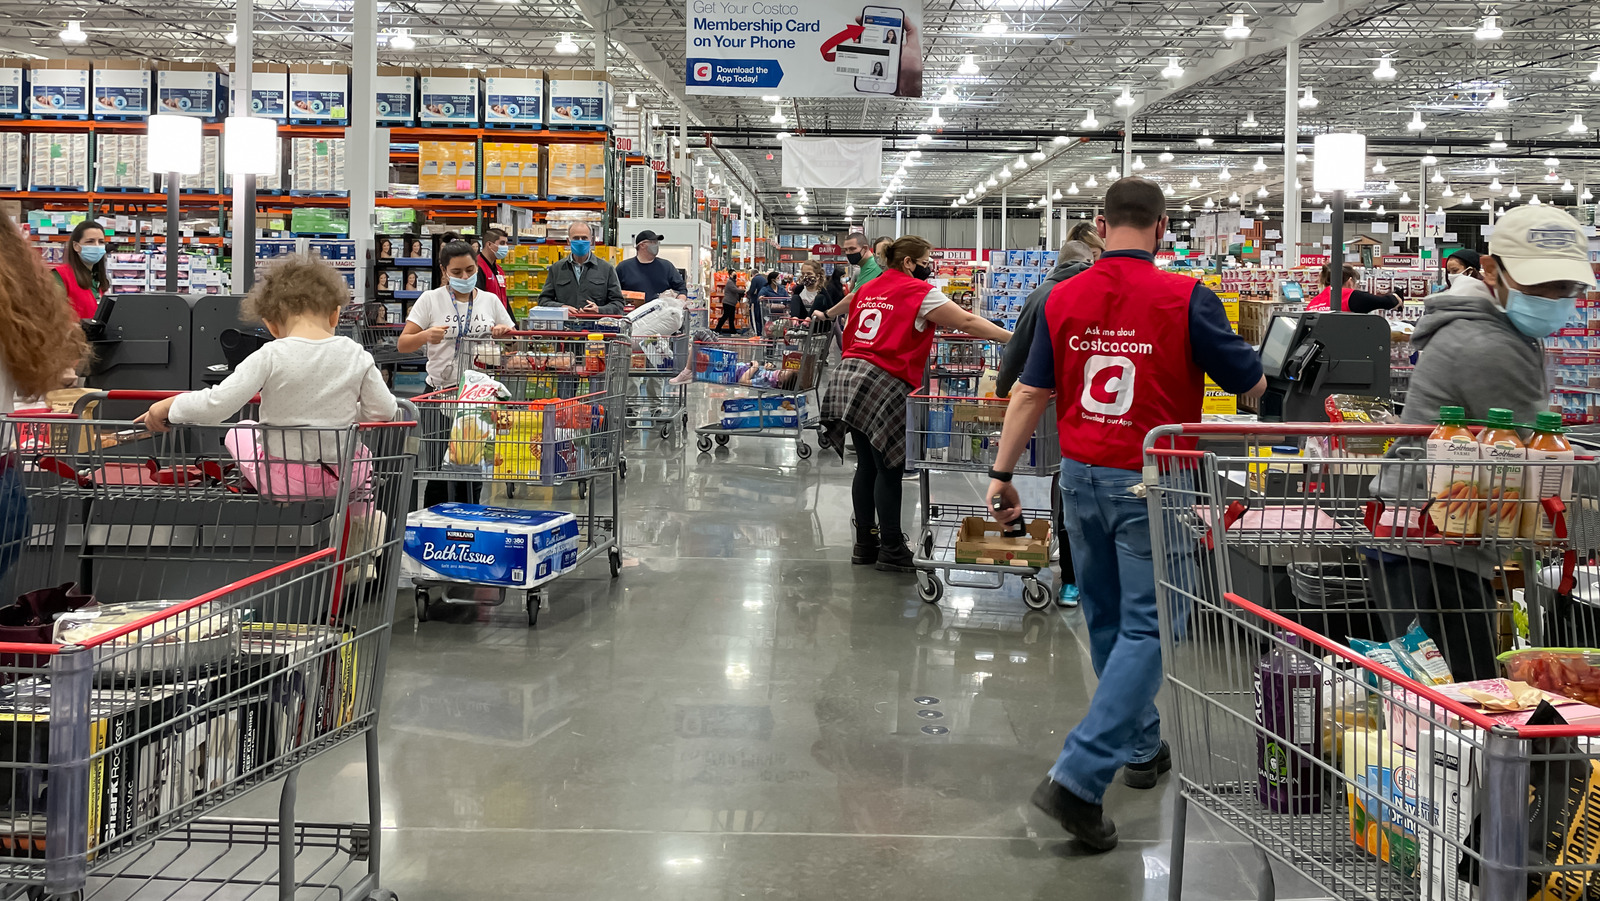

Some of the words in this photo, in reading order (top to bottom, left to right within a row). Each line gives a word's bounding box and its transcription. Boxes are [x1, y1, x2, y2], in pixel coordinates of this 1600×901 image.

[692, 0, 716, 14] Get
[720, 2, 748, 15] Your
[752, 2, 799, 15] Costco
[693, 17, 783, 34] Membership
[785, 19, 820, 32] Card
[693, 36, 711, 47] on
[714, 34, 747, 48] Your
[750, 35, 796, 49] Phone
[716, 66, 755, 75] Download
[755, 66, 769, 75] the
[716, 74, 732, 84] App
[733, 75, 758, 84] Today!
[55, 97, 61, 105] 3
[616, 137, 632, 151] 300
[651, 160, 666, 171] 302
[948, 251, 967, 259] DELI
[445, 314, 485, 323] SOCAL
[1085, 326, 1100, 335] Ask
[1069, 335, 1153, 354] Costco.com
[1081, 412, 1105, 423] Download
[1118, 418, 1133, 427] App
[1443, 442, 1477, 453] Bolthouse
[1486, 447, 1522, 459] Bolthouse
[447, 531, 474, 539] KIRKLAND
[423, 542, 458, 561] Bath
[457, 544, 496, 565] Tissue
[246, 710, 254, 753] CLEANING
[1394, 795, 1416, 816] Nav
[1421, 808, 1440, 826] MIK
